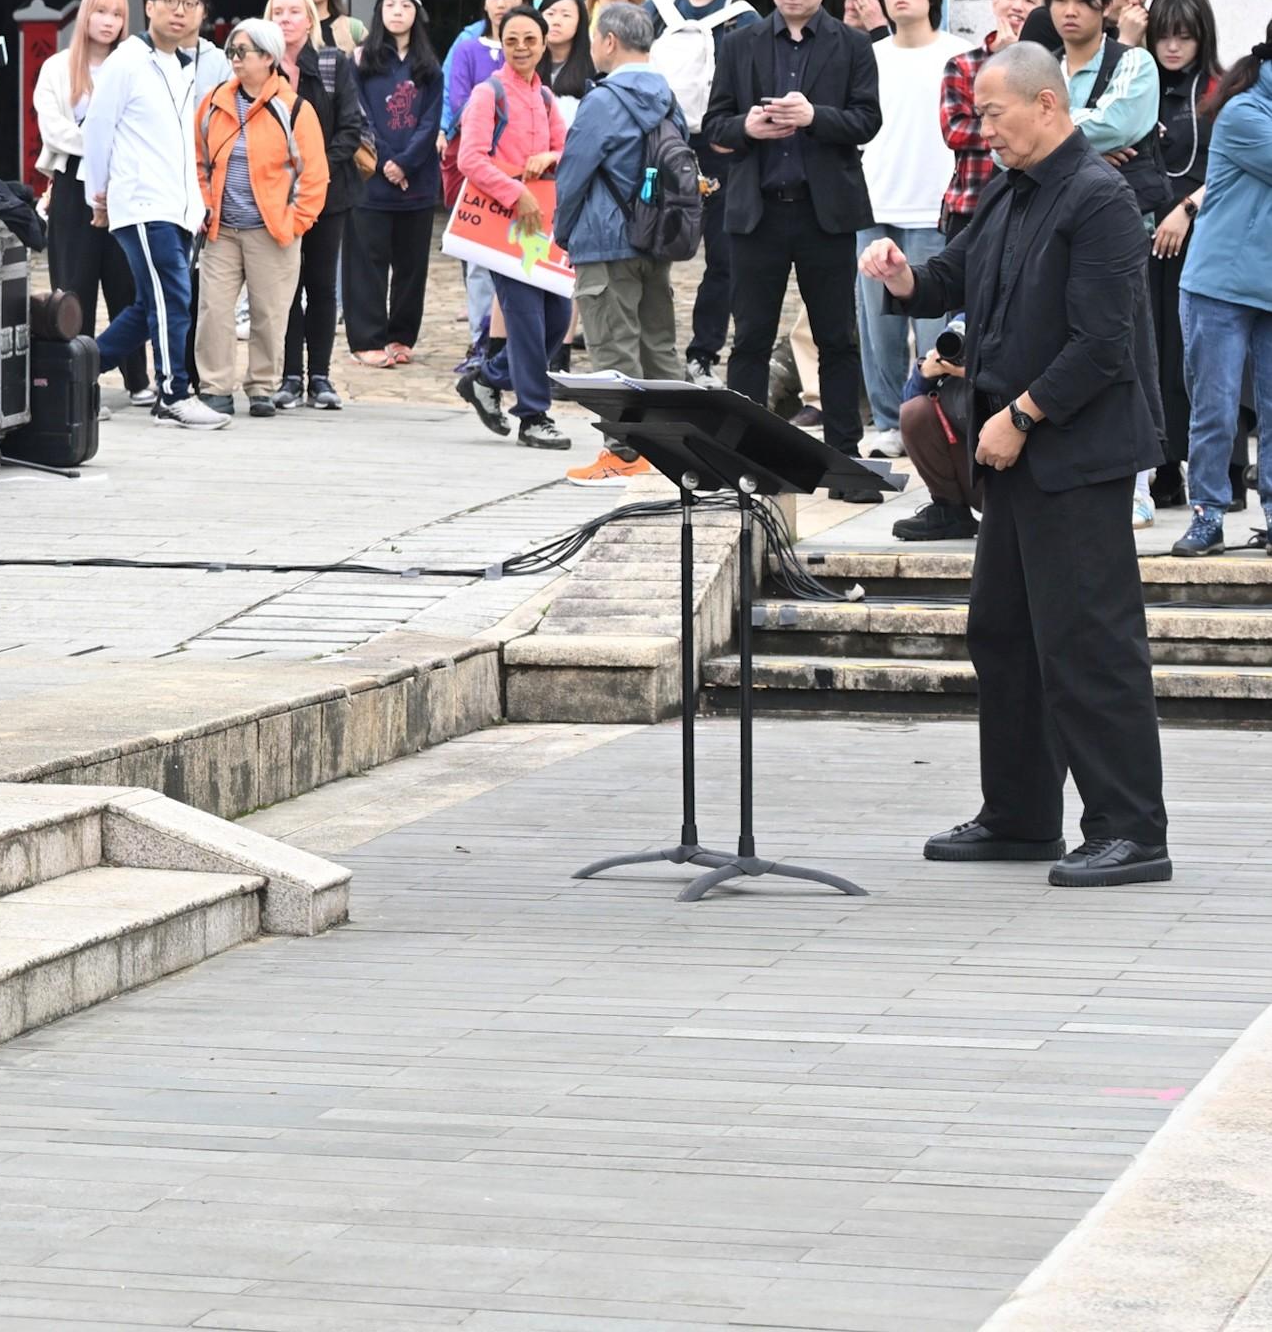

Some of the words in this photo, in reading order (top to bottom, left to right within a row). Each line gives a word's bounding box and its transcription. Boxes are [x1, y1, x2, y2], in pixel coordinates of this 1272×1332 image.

[463, 193, 486, 209] LAI
[489, 200, 514, 219] CHI
[457, 210, 482, 225] WO
